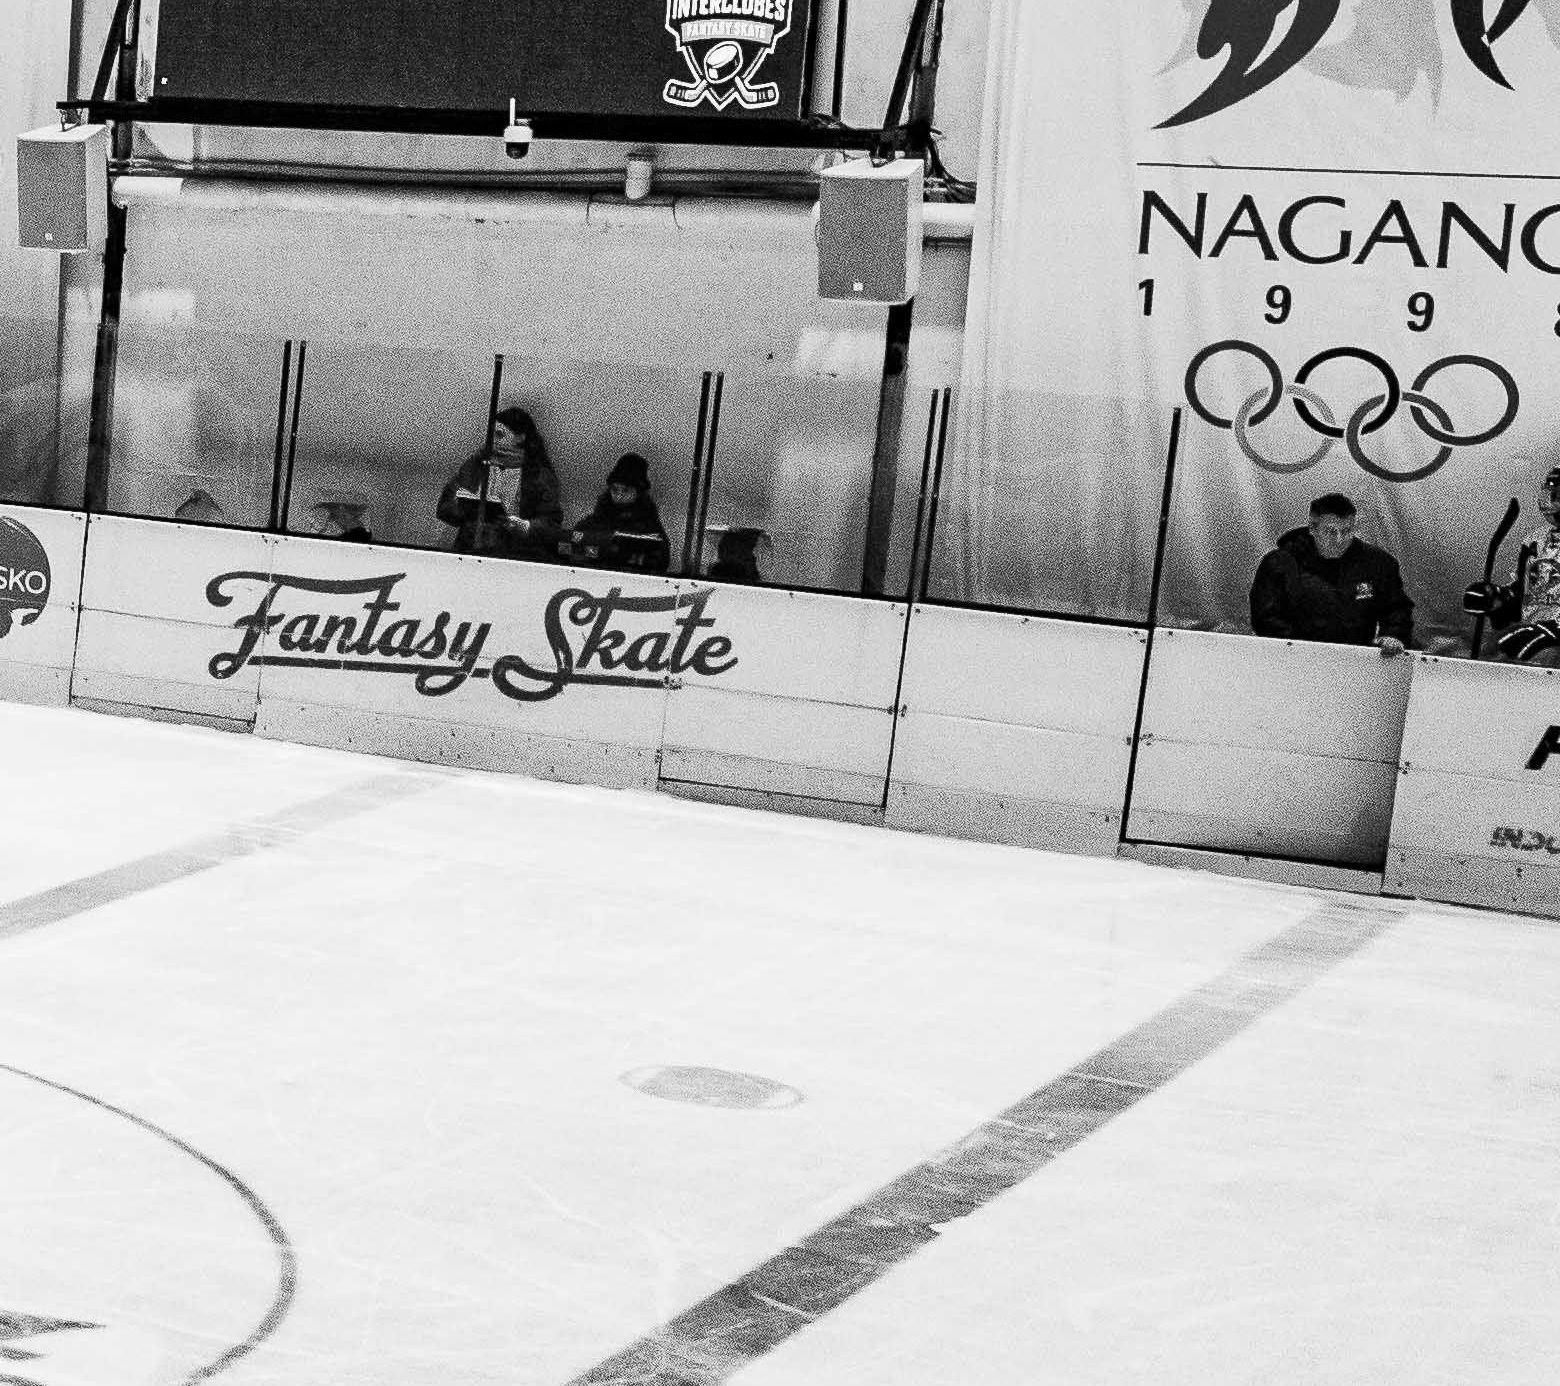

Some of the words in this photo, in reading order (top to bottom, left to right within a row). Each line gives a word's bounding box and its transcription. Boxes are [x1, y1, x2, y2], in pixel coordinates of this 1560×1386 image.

[686, 22, 731, 39] FANTASY
[731, 23, 768, 40] SKATE
[206, 570, 493, 697] Fantasy
[492, 585, 738, 702] Skate
